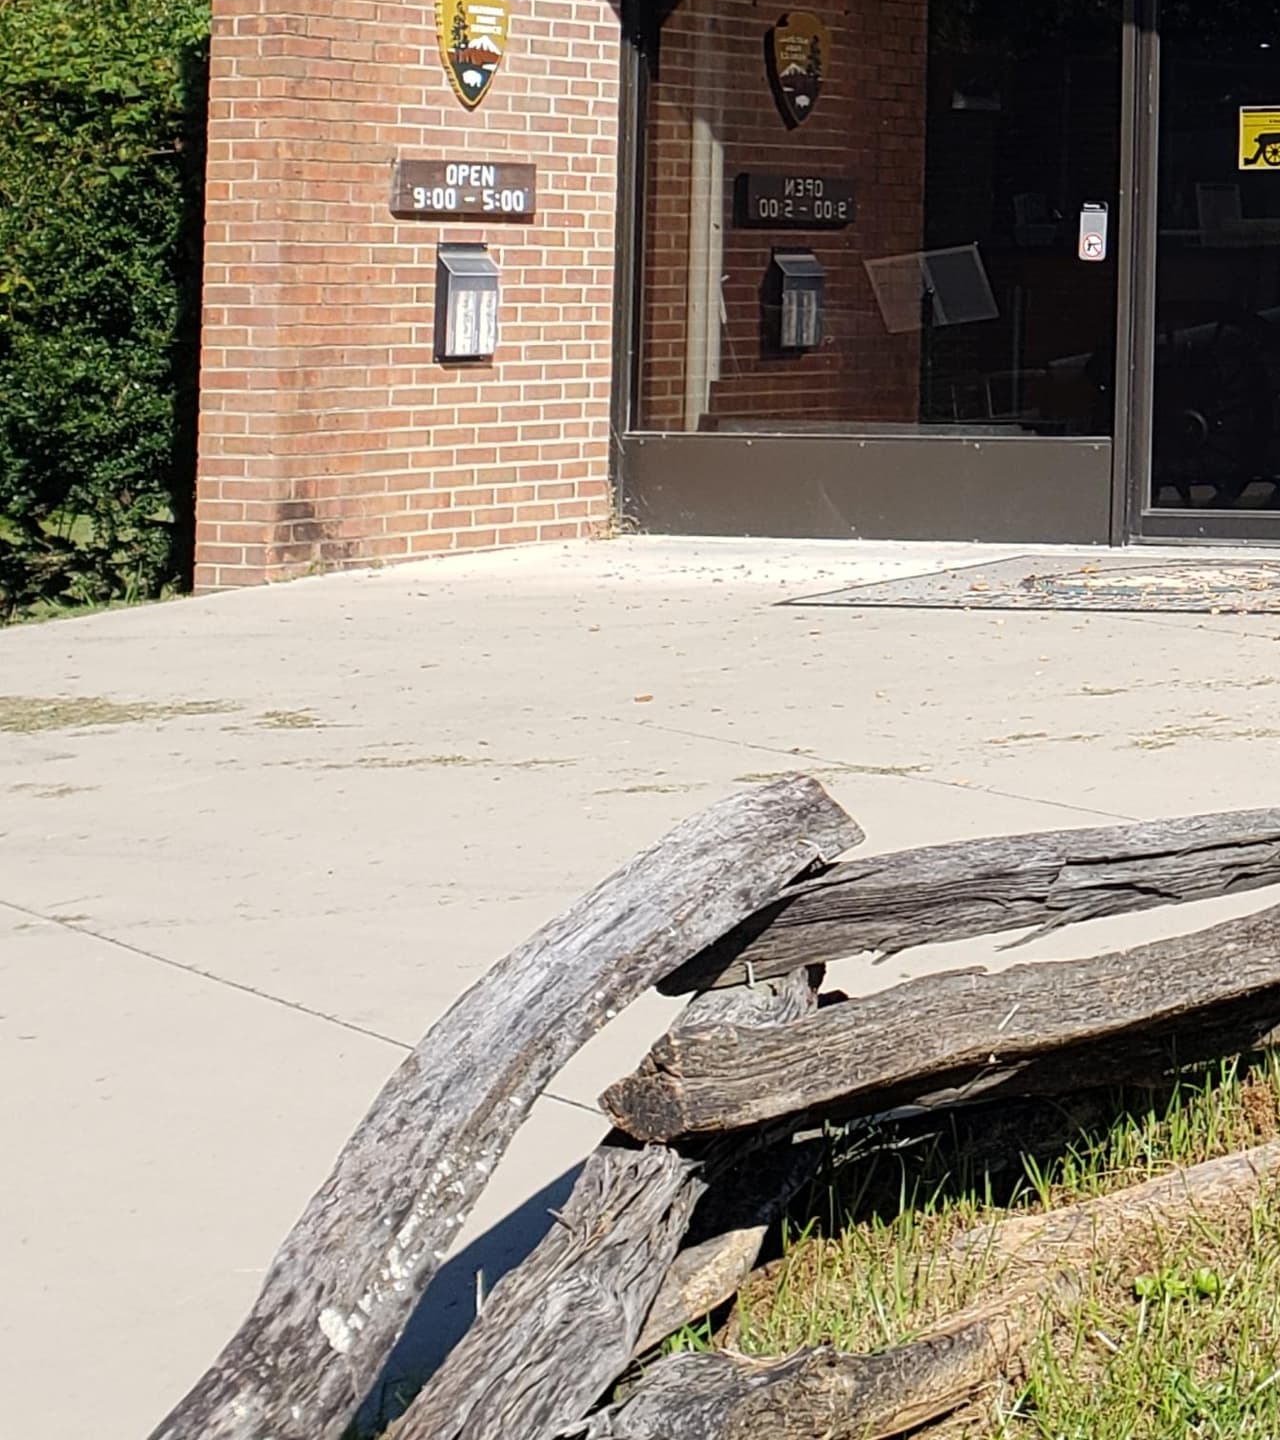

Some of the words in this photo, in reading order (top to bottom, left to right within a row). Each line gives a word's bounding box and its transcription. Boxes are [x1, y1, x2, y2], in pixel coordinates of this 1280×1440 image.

[445, 163, 496, 187] OPEN
[413, 186, 456, 210] 9:00
[481, 188, 525, 212] 5:00
